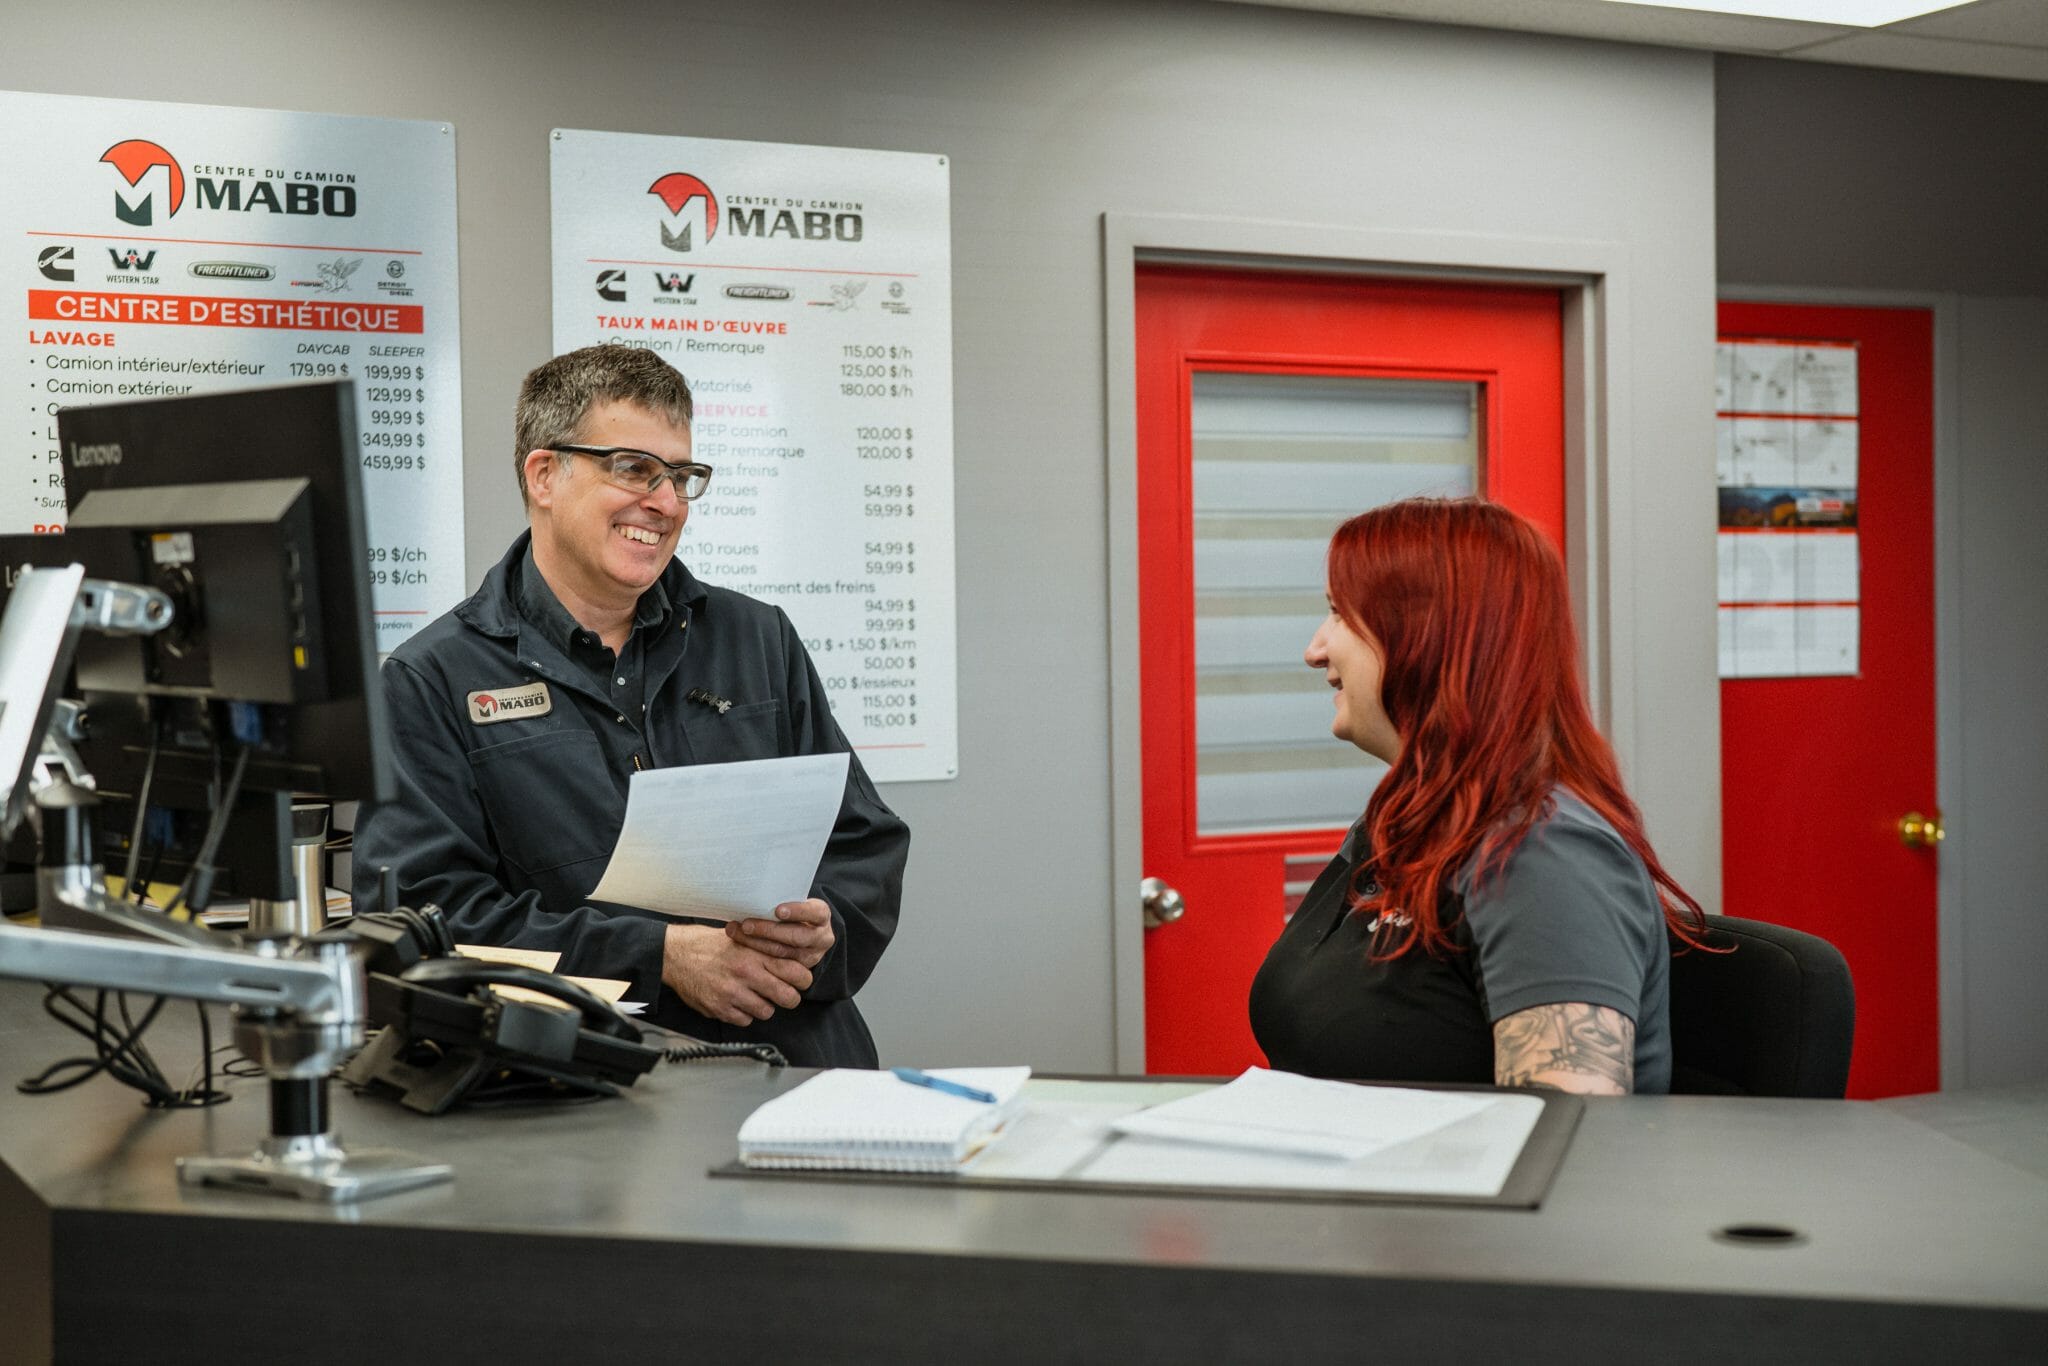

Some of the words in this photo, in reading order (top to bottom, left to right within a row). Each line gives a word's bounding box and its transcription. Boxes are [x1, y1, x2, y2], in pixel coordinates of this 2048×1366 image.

[194, 165, 255, 177] CENTRE
[265, 169, 285, 179] DU
[294, 171, 356, 183] CAMION
[196, 177, 357, 218] MABO
[726, 195, 778, 206] CENTRE
[786, 199, 803, 207] DU
[810, 200, 863, 210] CAMION
[728, 206, 863, 242] MABO
[197, 265, 267, 277] FREIGHTLINER
[106, 274, 140, 284] WESTERN
[142, 276, 160, 285] STAR
[55, 295, 179, 321] CENTRE
[190, 300, 399, 331] D'ESTHÉTIQUE
[597, 316, 644, 329] TAUX
[651, 318, 698, 331] MAIN
[30, 330, 115, 346] LAVAGE
[297, 342, 350, 355] DAYCAB
[369, 345, 425, 357] SLEEPER
[686, 339, 765, 355] Remorque
[843, 345, 886, 359] 115,00
[890, 345, 912, 359] $/h
[46, 354, 113, 370] Camion
[118, 356, 265, 375] intérieur/extérieur
[290, 362, 335, 378] 179,99
[340, 362, 349, 376] $
[841, 364, 886, 378] 125,00
[890, 364, 913, 378] $/h
[365, 365, 411, 380] 199,99
[415, 365, 425, 381] $
[47, 378, 113, 394] Camion
[118, 380, 193, 395] extérieur
[840, 383, 886, 397] 180,00
[890, 383, 913, 397] $/h
[366, 388, 412, 403] 129,99
[415, 388, 425, 403] $
[693, 403, 768, 417] SERVICE
[371, 410, 412, 426] 99,99
[416, 410, 425, 426] $
[696, 423, 727, 437] PEP
[731, 426, 788, 438] camion
[857, 426, 902, 441] 120,00
[905, 427, 913, 440] $
[362, 432, 413, 449] 349,99
[416, 433, 425, 448] $
[70, 441, 123, 467] Lenovo
[697, 443, 727, 456] PEP
[731, 446, 805, 459] remorque
[857, 446, 902, 460] 120,00
[906, 446, 913, 460] $
[363, 455, 413, 471] 459,99
[416, 455, 426, 471] $
[864, 484, 902, 498] 54,99
[906, 484, 914, 498] $
[697, 503, 710, 516] 12
[714, 505, 756, 516] roues
[864, 503, 902, 518] 59,99
[907, 503, 914, 517] $
[391, 547, 427, 562] $/ch
[697, 542, 714, 555] 10
[717, 544, 759, 555] roues
[864, 541, 903, 556] 54,99
[907, 541, 915, 555] $
[698, 562, 711, 575] 12
[715, 564, 757, 575] roues
[865, 561, 903, 575] 59,99
[907, 561, 915, 574] $
[391, 569, 428, 585] $/ch
[805, 580, 831, 593] des
[835, 580, 876, 593] freins
[865, 599, 903, 613] 94,99
[908, 599, 915, 612] $
[865, 618, 904, 632] 99,99
[908, 618, 915, 631] $
[825, 638, 832, 651] $
[849, 637, 875, 652] 1,50
[880, 637, 916, 651] $/km
[865, 657, 904, 671] 50,00
[908, 656, 916, 669] $
[500, 695, 545, 710] MABO
[863, 695, 905, 709] 115,00
[909, 694, 916, 706] $
[863, 714, 905, 727] 115,00
[909, 713, 916, 726] $
